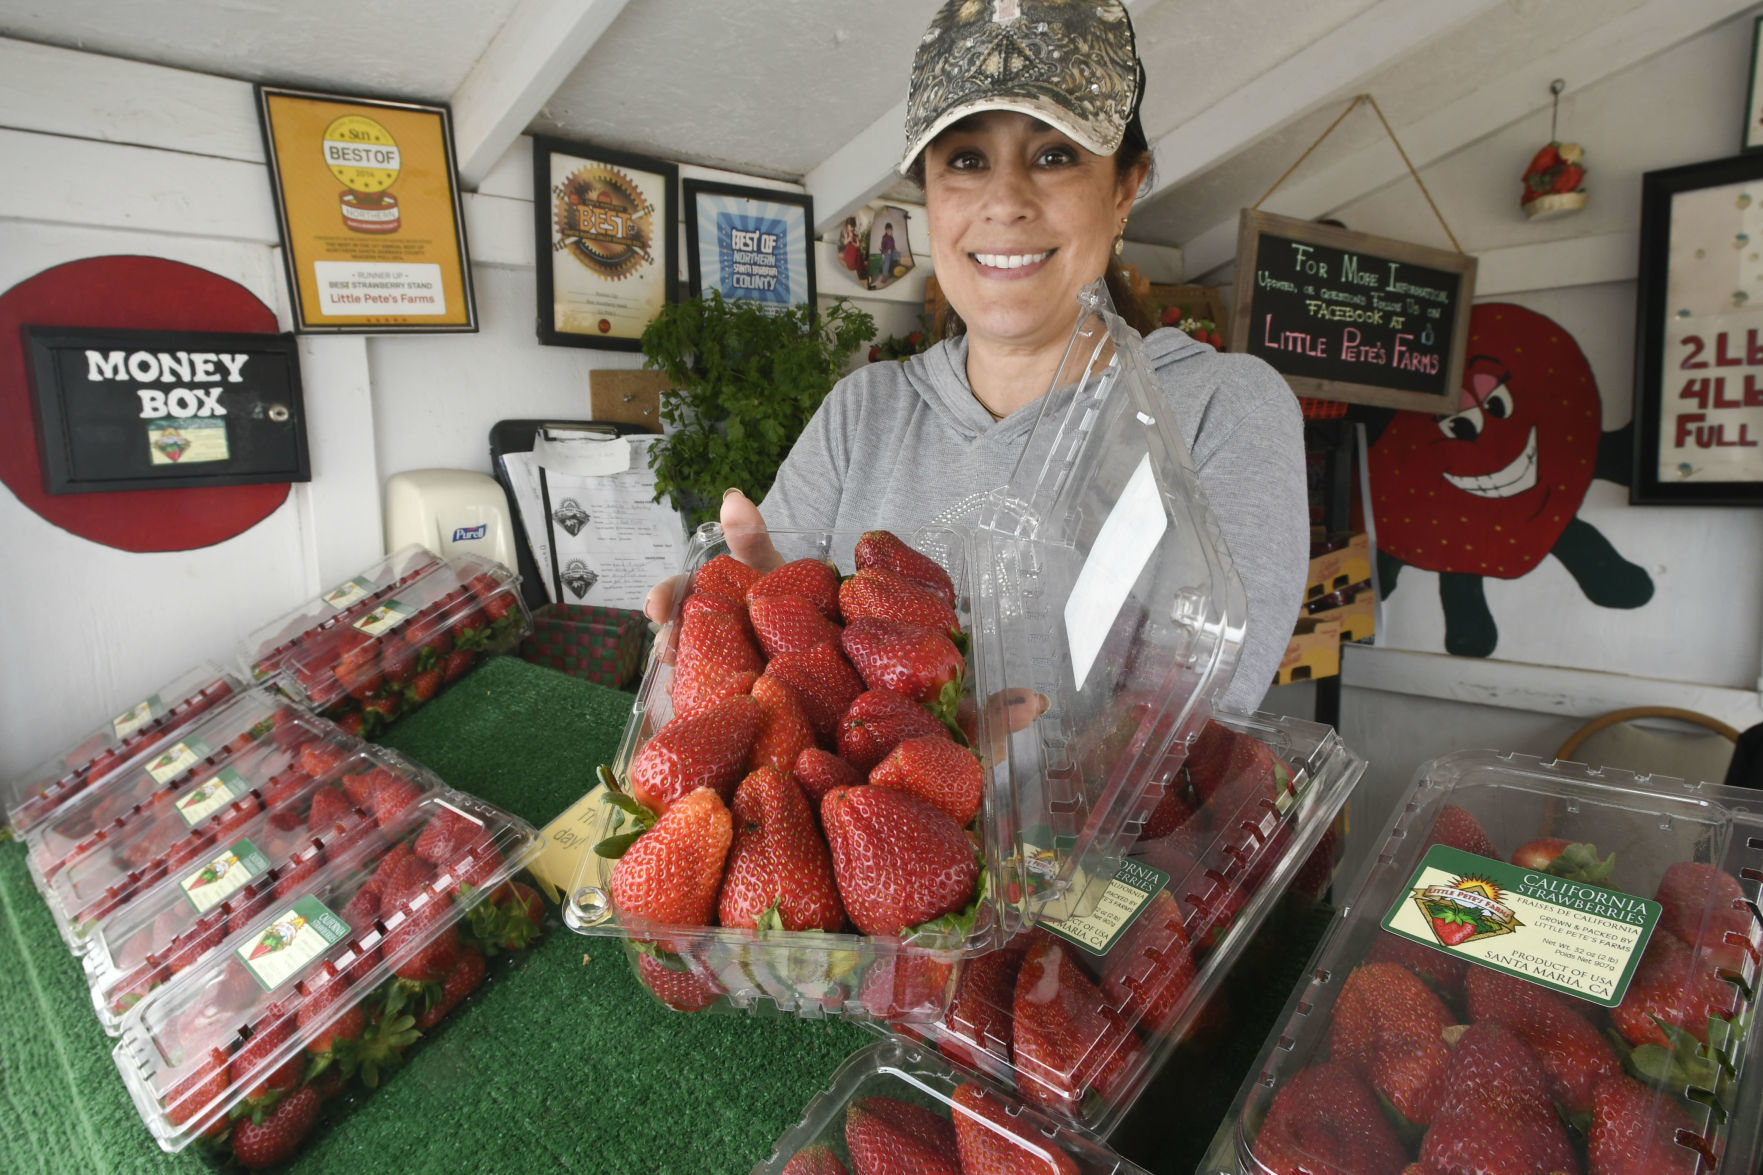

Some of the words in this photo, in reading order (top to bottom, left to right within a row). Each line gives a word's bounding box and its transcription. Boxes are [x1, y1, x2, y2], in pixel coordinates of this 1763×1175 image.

[329, 146, 372, 163] BEST
[374, 150, 395, 164] OF
[577, 204, 632, 238] BEST
[732, 229, 760, 252] BEST
[761, 234, 777, 254] OF
[733, 250, 776, 266] NORTHERN
[328, 281, 350, 289] BEST
[351, 281, 405, 289] STRAWBERRY
[407, 281, 433, 289] STAND
[357, 271, 391, 279] RUNNER
[733, 274, 777, 291] COUNTY
[330, 293, 361, 304] Little
[364, 293, 398, 304] Pete's
[401, 293, 435, 304] Farms
[1305, 299, 1384, 325] FACEBOOK
[1389, 316, 1406, 329] AT
[84, 349, 249, 383] MONEY
[137, 387, 227, 418] BOX
[553, 827, 586, 850] day!
[1427, 888, 1454, 896] LITTLE
[1523, 874, 1648, 915] CALIFORNIA
[1516, 884, 1646, 925] STRAWBERRIES
[1516, 897, 1554, 912] FRAISES
[1557, 908, 1570, 916] DE
[1573, 913, 1639, 935] CALIFORNIA
[1083, 923, 1095, 931] OF
[1094, 929, 1109, 940] USA
[1534, 920, 1563, 933] LITTLE
[1565, 930, 1598, 943] PETE'S
[1599, 940, 1632, 953] FARMS
[1539, 914, 1572, 928] GROWN
[1582, 927, 1618, 941] PACKED
[1620, 936, 1633, 944] BY
[1090, 936, 1103, 947] CA
[1542, 938, 1556, 946] Net
[1573, 946, 1585, 954] 32
[1511, 949, 1570, 973] PRODUCT
[1571, 968, 1589, 979] OF
[1590, 974, 1613, 987] USA
[1554, 949, 1576, 960] Poids
[1577, 955, 1592, 964] Net
[1593, 961, 1615, 972] 907g
[1484, 950, 1528, 971] SANTA
[1588, 983, 1609, 997] CA
